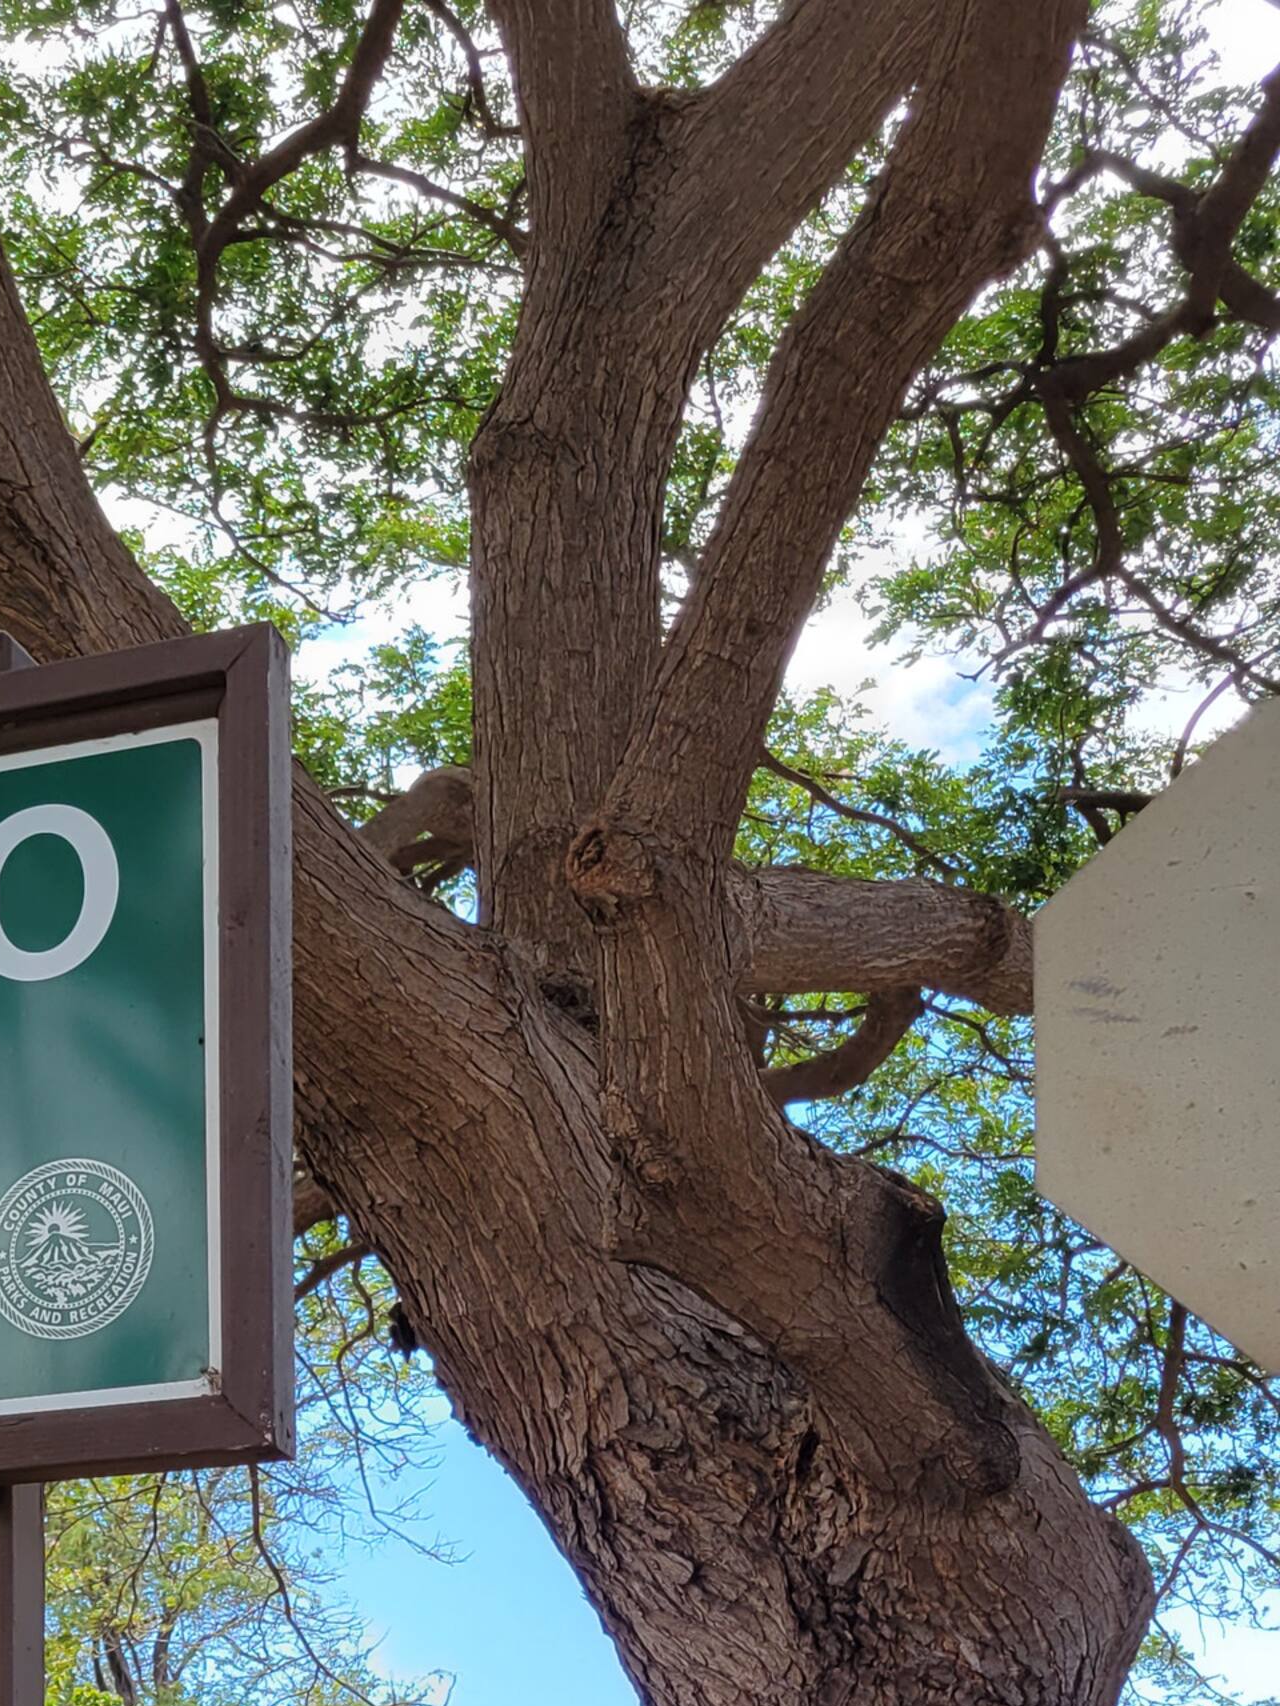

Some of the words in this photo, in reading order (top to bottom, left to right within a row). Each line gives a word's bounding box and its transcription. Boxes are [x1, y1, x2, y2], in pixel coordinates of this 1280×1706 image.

[3, 1176, 57, 1232] COUNTY
[66, 1173, 88, 1187] OF
[98, 1182, 133, 1220] MAUI
[29, 1308, 62, 1324] AND
[69, 1251, 138, 1324] RECREATION
